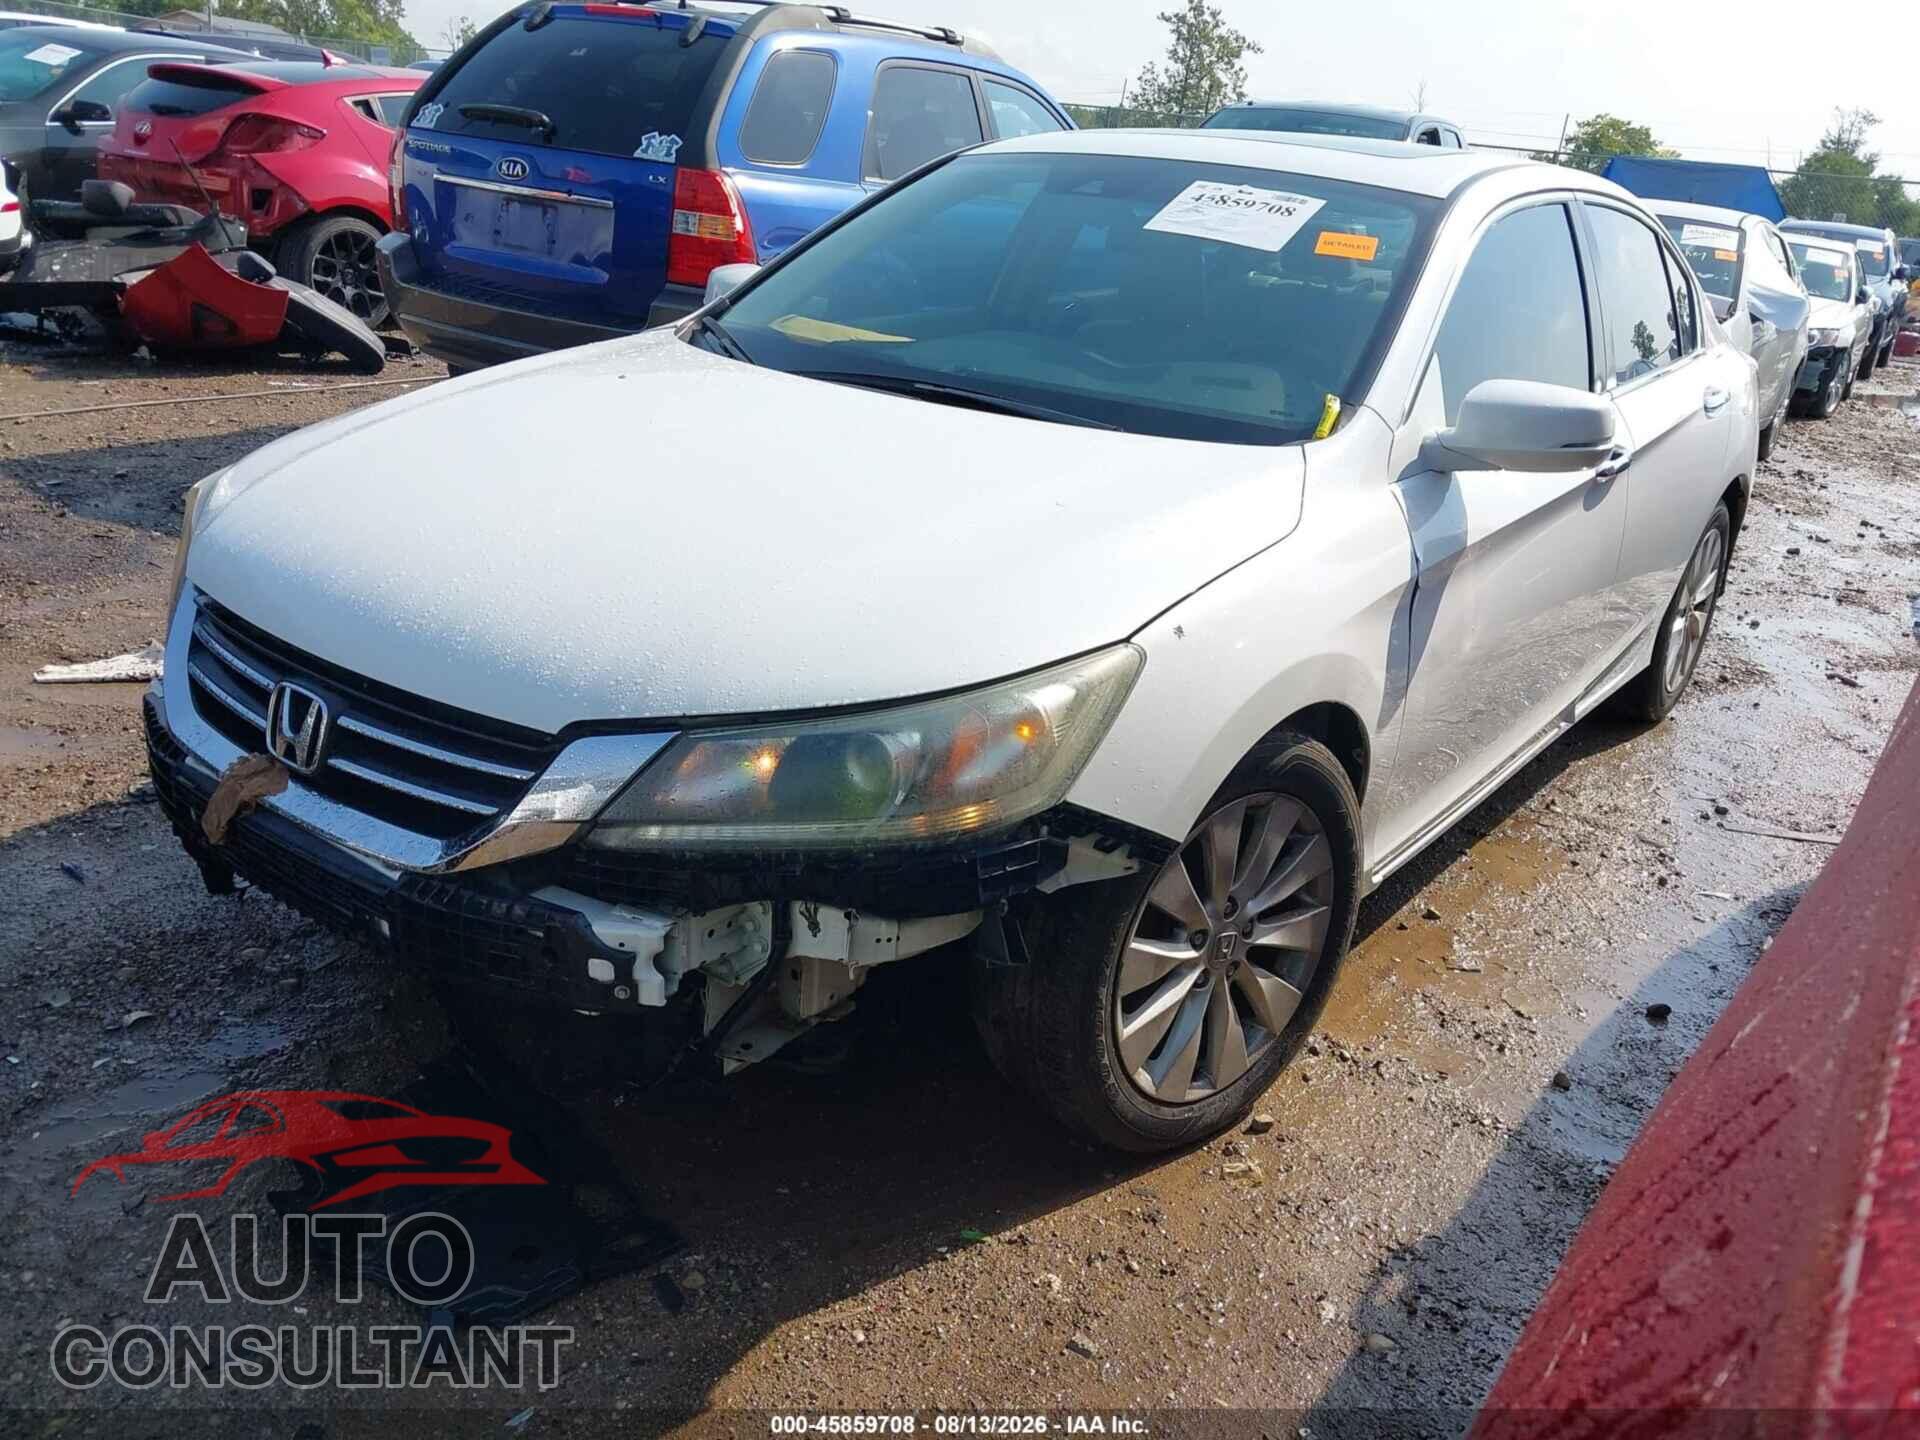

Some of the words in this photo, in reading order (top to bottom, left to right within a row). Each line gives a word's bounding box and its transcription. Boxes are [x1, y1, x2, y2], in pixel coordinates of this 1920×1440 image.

[500, 161, 522, 176] KIA
[648, 175, 667, 184] LX
[1191, 193, 1297, 217] 45859708
